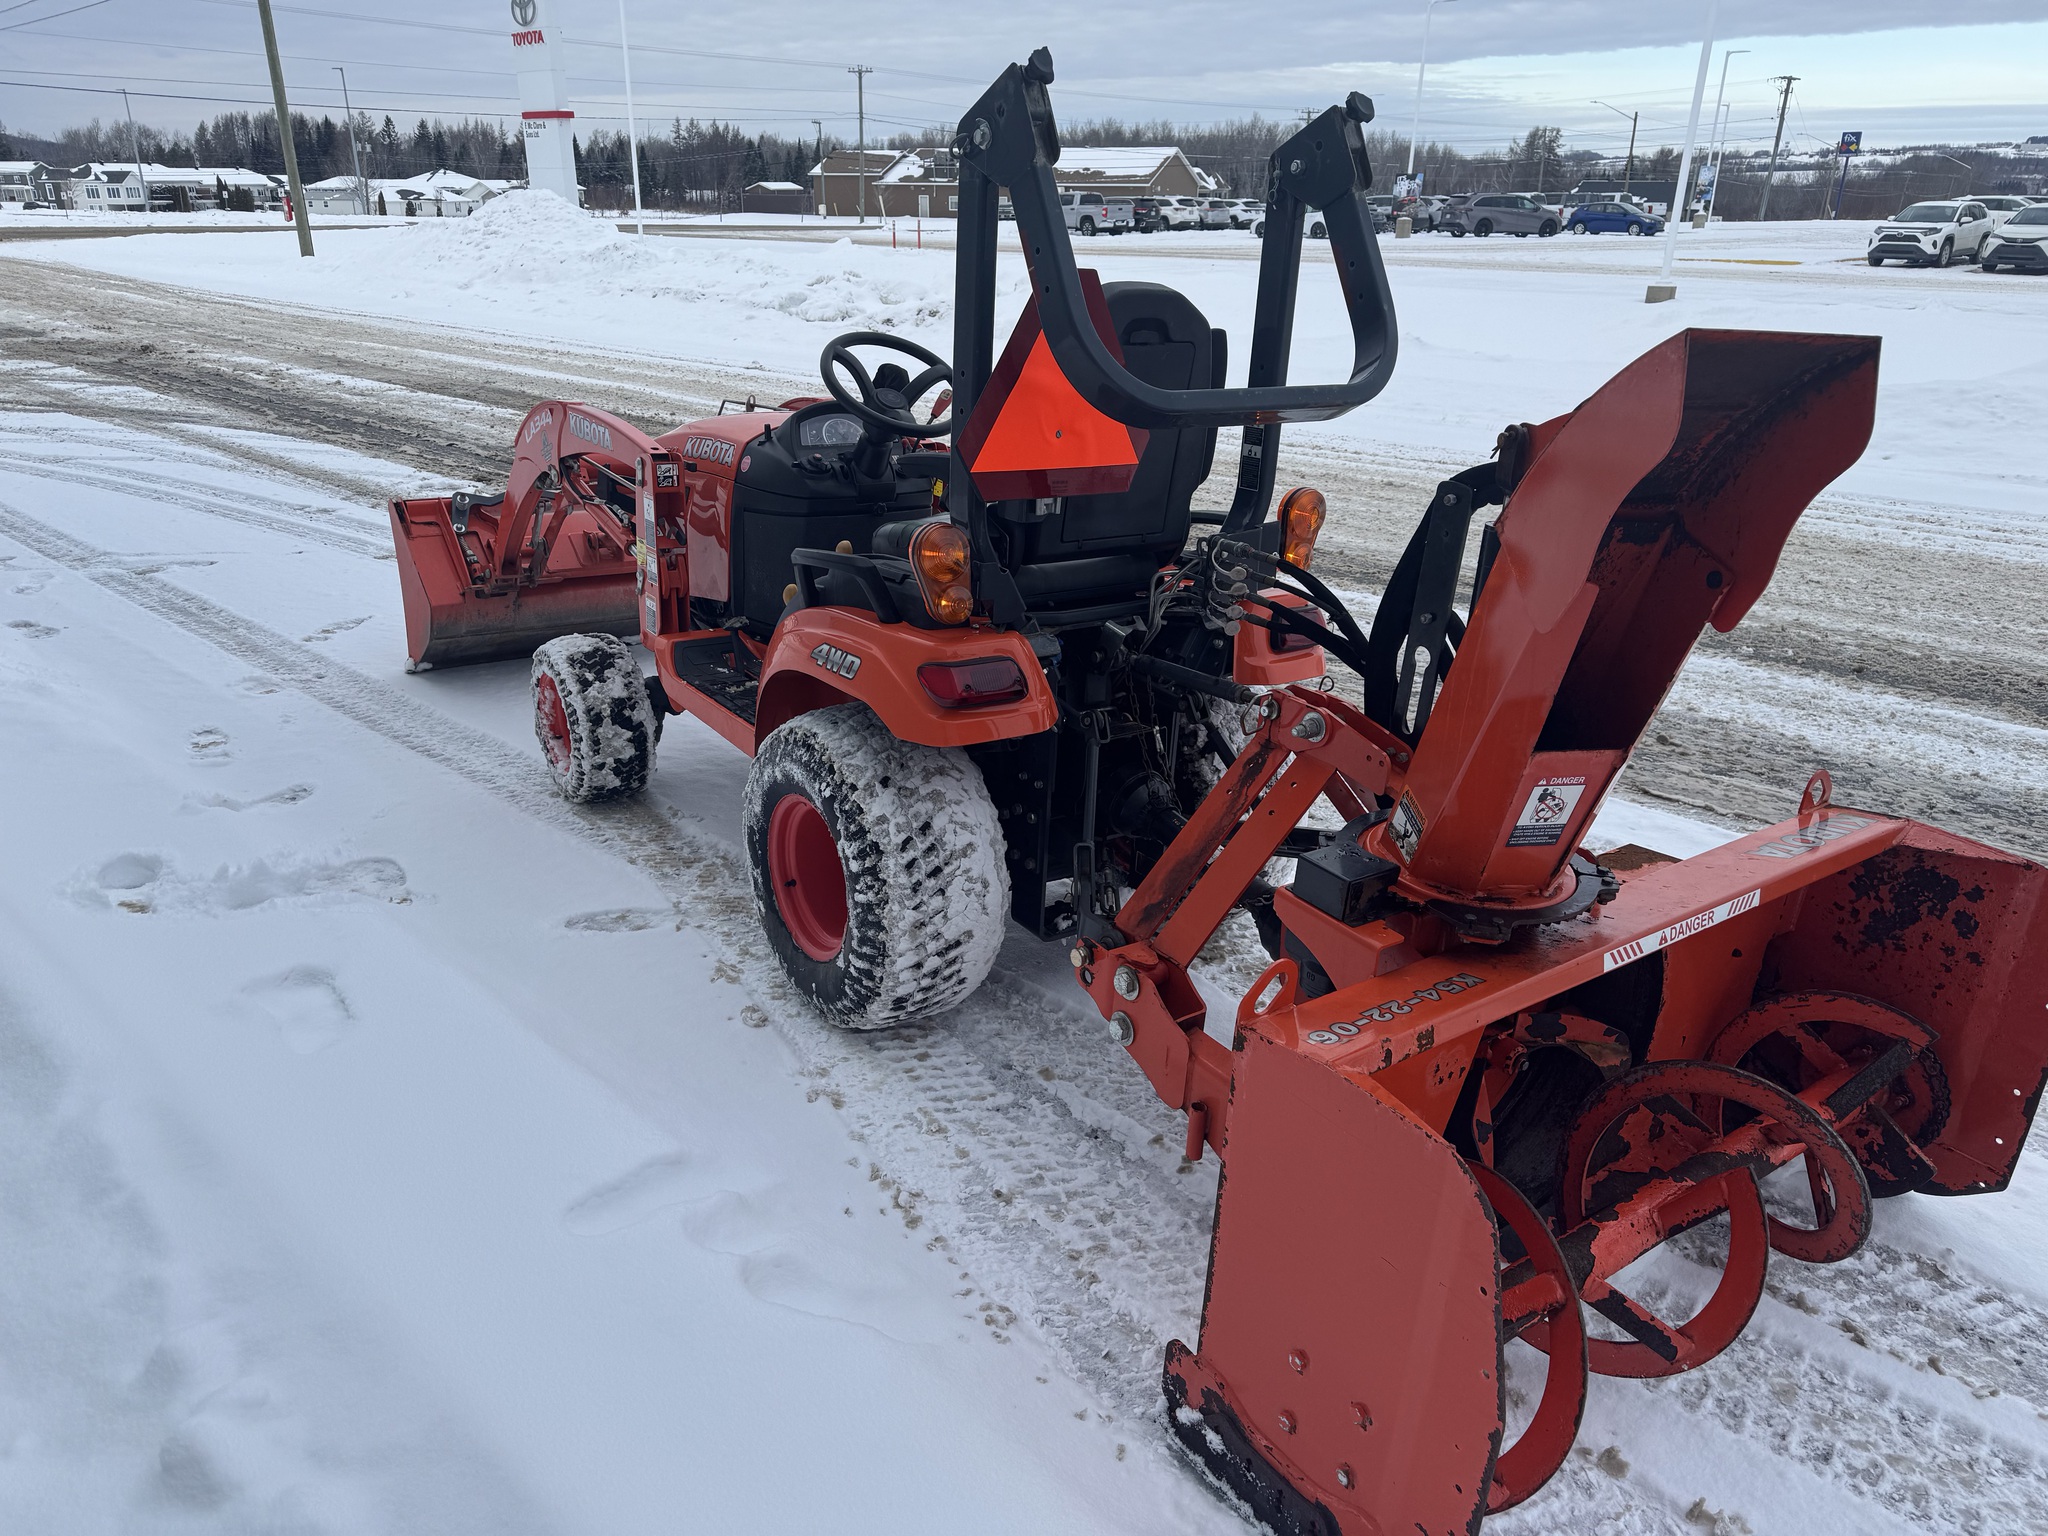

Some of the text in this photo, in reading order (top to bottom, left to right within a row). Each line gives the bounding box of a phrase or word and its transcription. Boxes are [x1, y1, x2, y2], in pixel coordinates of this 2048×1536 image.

[511, 30, 545, 46] TOYOTA
[1844, 133, 1857, 143] fix
[525, 408, 553, 444] LA344
[569, 411, 614, 451] KUBOTA
[682, 436, 736, 468] KUBOTA
[810, 641, 862, 680] 4WD
[1549, 776, 1585, 785] DANGER
[1744, 813, 1879, 859] KUBOTA
[1669, 910, 1715, 942] DANGER
[1308, 972, 1487, 1045] K54-22-06
